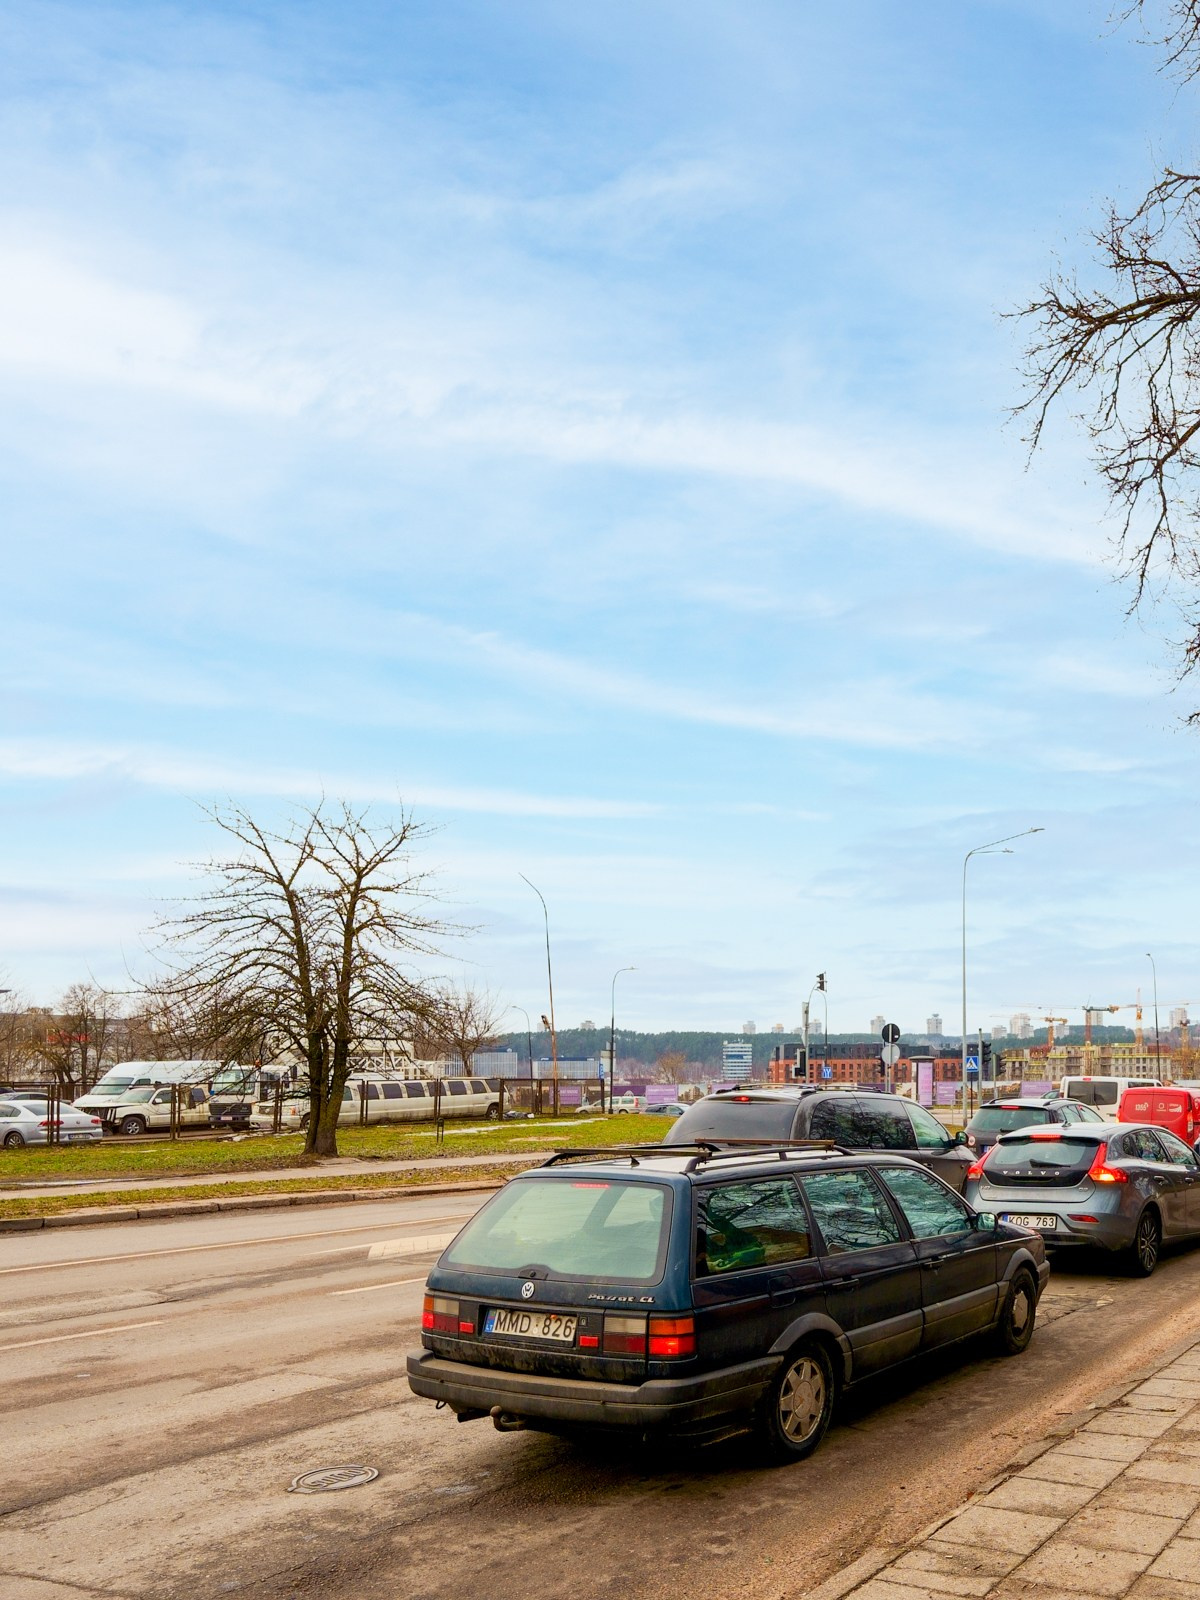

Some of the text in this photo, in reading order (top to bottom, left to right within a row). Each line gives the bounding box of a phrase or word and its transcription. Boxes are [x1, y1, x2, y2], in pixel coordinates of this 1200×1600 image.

[1036, 1217, 1055, 1227] 763
[485, 1324, 493, 1332] LT
[494, 1311, 574, 1338] MMD 826
